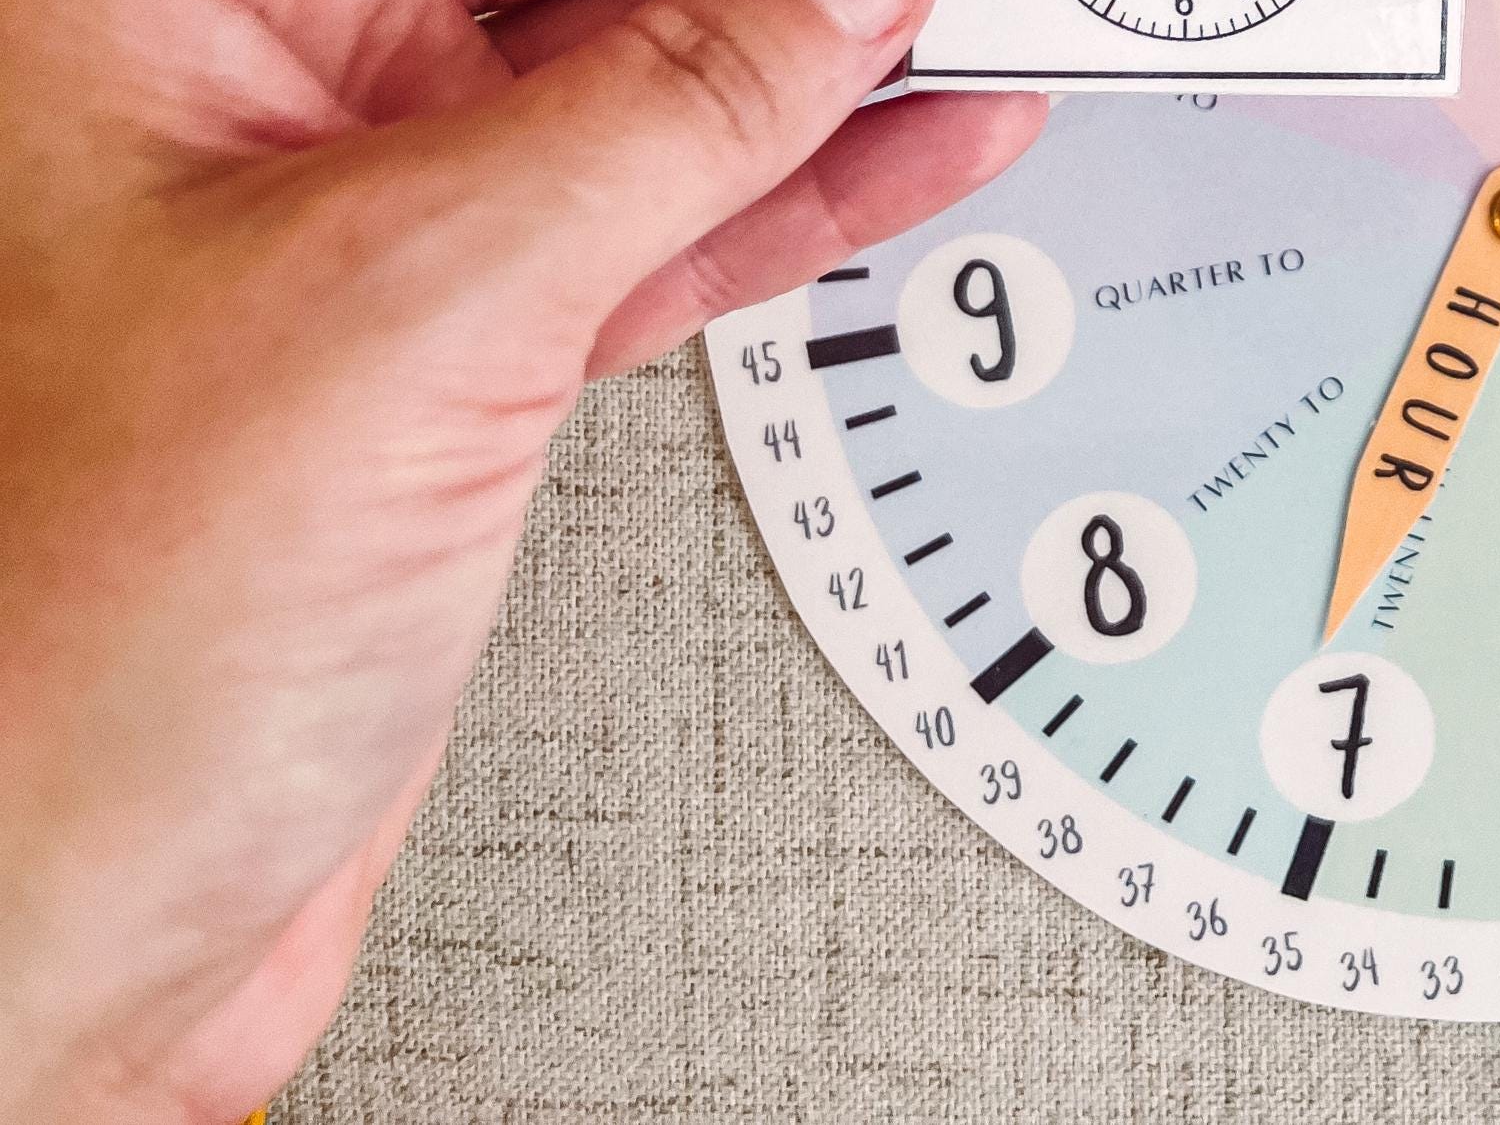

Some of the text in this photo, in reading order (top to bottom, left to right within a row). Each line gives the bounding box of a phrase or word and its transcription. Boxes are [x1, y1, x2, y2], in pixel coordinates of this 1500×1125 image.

[1095, 248, 1304, 310] QUARTER TO
[953, 259, 1016, 383] 9
[741, 341, 782, 386] 45
[763, 419, 801, 462] 44
[1186, 376, 1344, 512] TWENTY TO
[793, 496, 835, 540] 43
[828, 567, 868, 611] 42
[1081, 514, 1147, 637] 8
[875, 639, 909, 682] 41
[915, 706, 955, 749] 40
[1318, 673, 1373, 799] 7
[979, 760, 1022, 805] 39
[1037, 814, 1083, 860] 38
[1118, 862, 1155, 907] 37
[1186, 897, 1228, 941] 36
[1261, 931, 1303, 976] 35
[1339, 947, 1379, 992] 34
[1421, 956, 1464, 1000] 33
